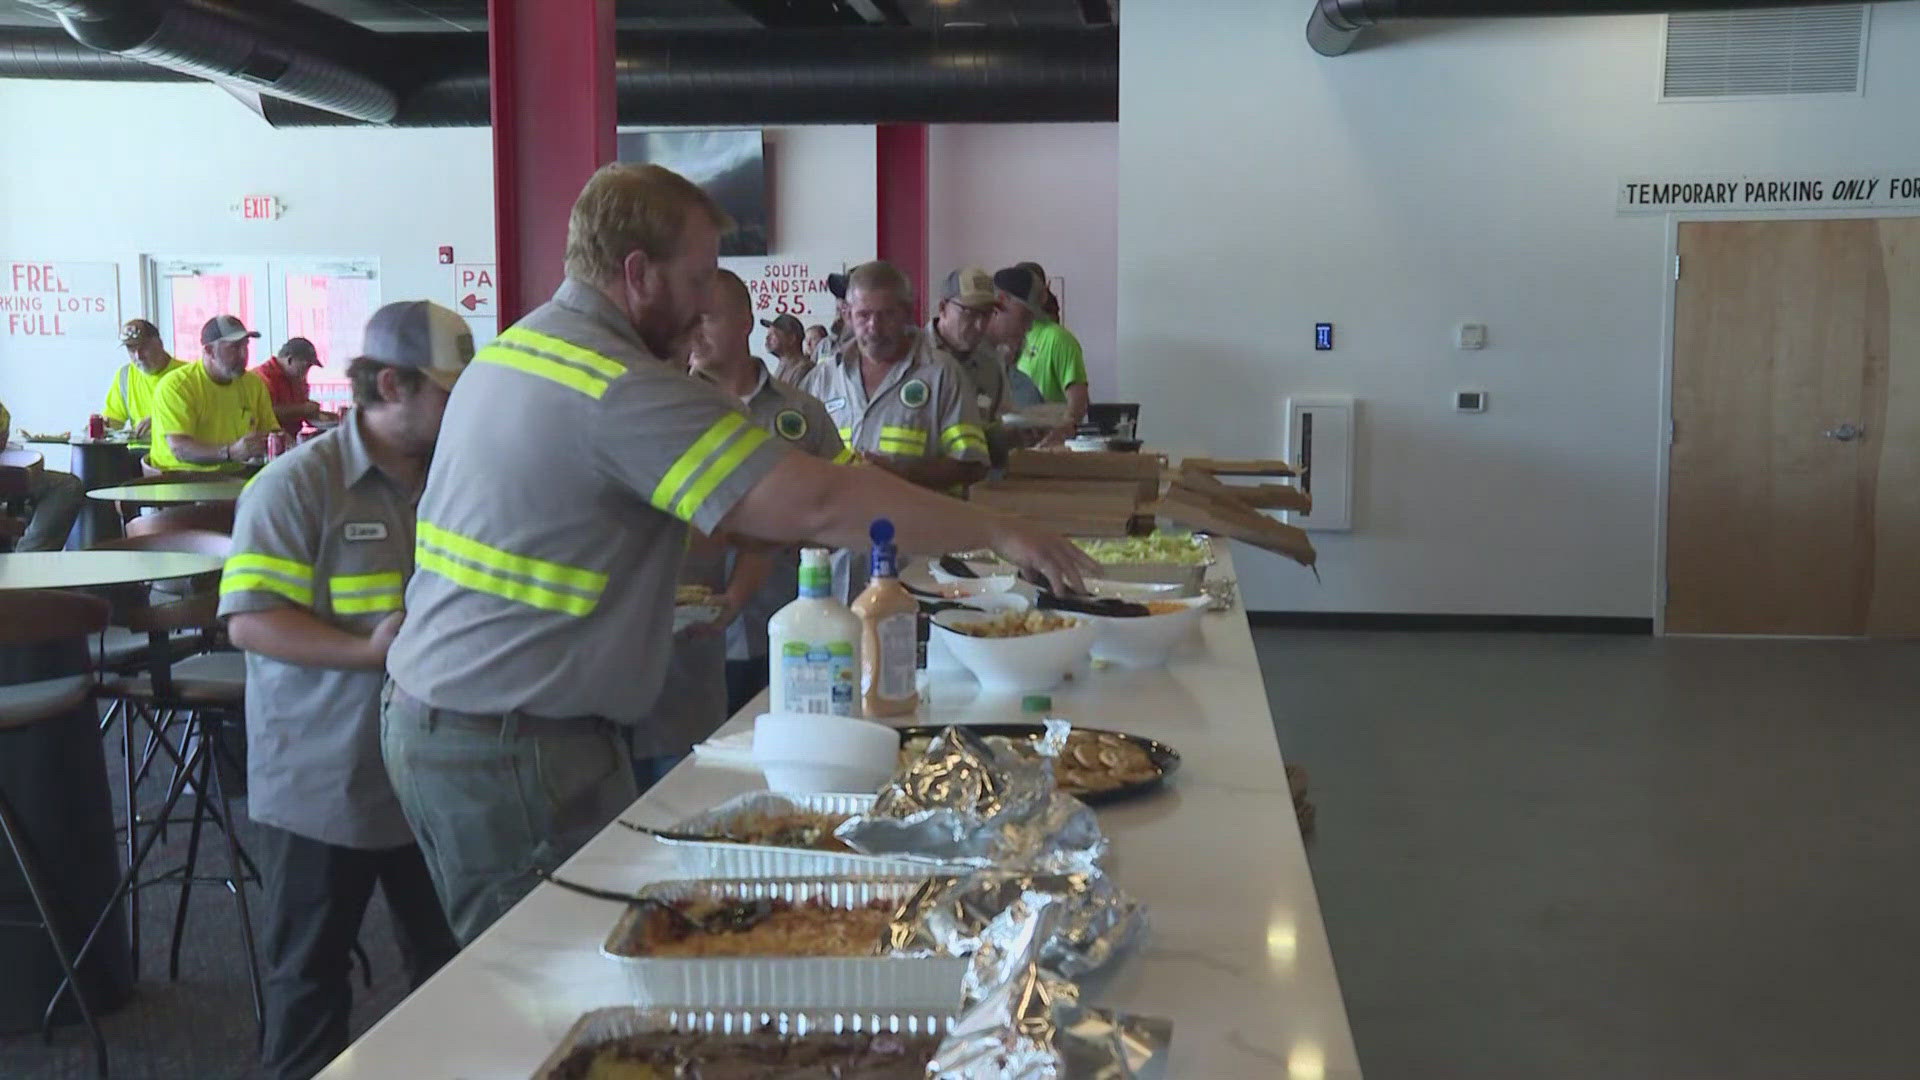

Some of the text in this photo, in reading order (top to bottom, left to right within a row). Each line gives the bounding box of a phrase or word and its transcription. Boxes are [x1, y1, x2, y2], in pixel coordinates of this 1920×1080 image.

[1626, 182, 1738, 204] TEMPORARY
[1745, 181, 1823, 203] PARKING
[1831, 179, 1879, 201] ONLY
[244, 197, 271, 218] EXIT
[764, 265, 809, 278] SOUTH
[744, 279, 829, 294] RANDSTAN
[57, 297, 105, 312] LOTS
[9, 313, 66, 336] FULL
